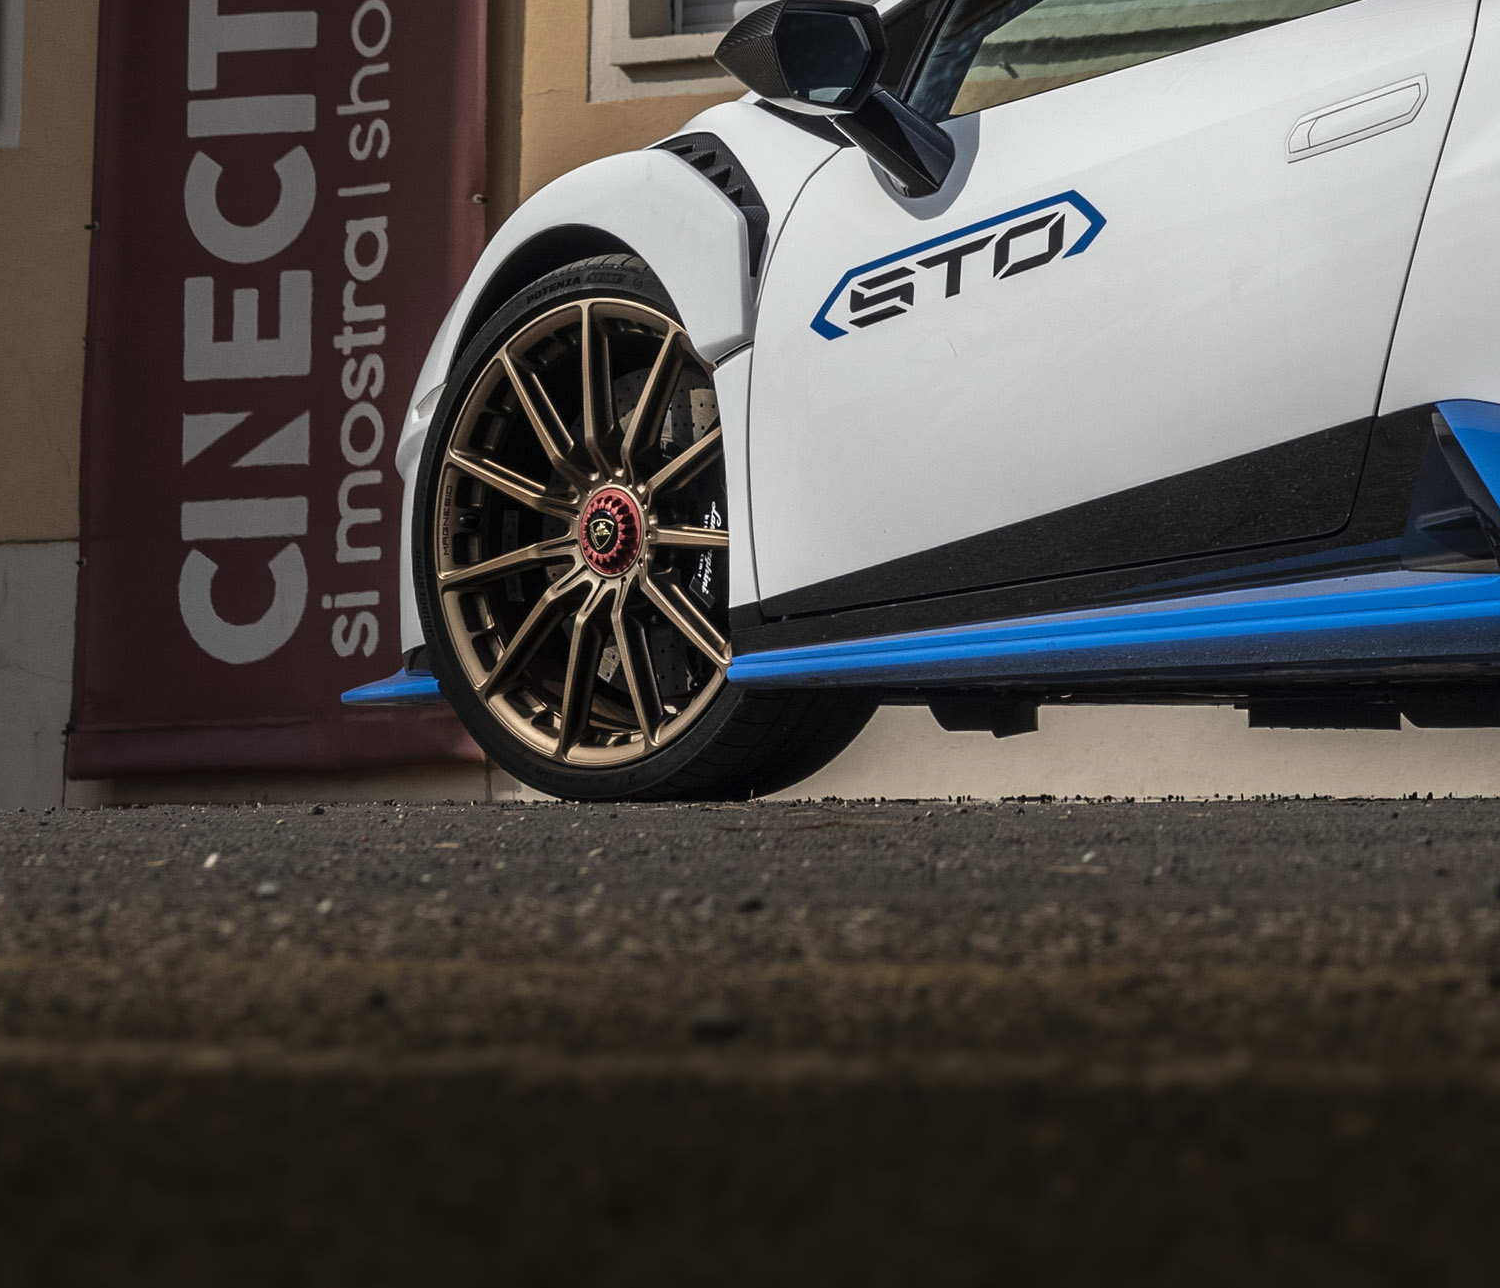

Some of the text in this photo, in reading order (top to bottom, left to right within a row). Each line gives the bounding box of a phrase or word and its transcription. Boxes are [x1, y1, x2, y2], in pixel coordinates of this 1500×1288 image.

[526, 276, 582, 304] POTENZA
[848, 211, 1066, 329] STO
[333, 215, 389, 564] mostra
[443, 484, 453, 556] MAGNESIO
[324, 590, 380, 658] si
